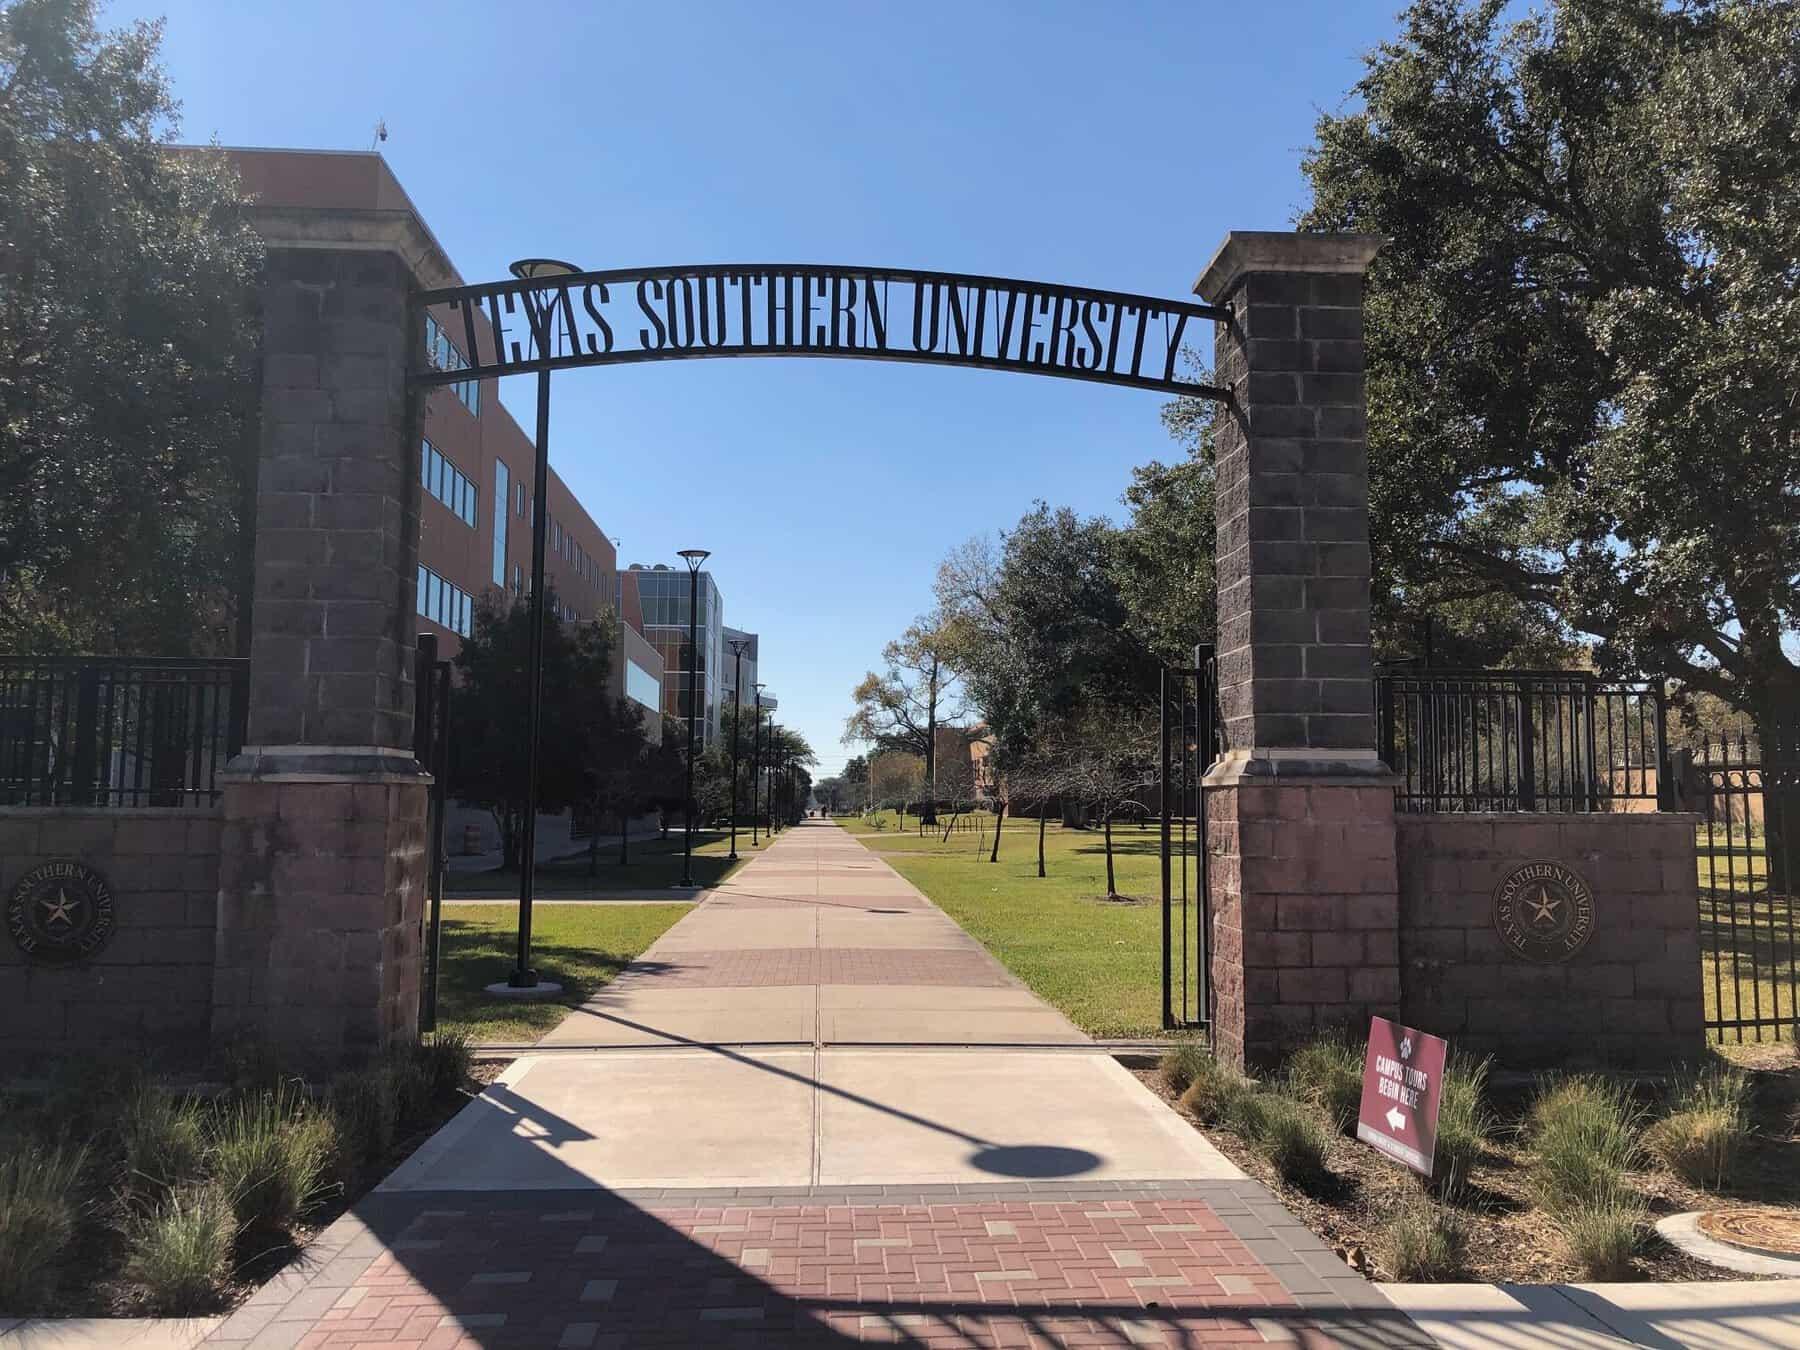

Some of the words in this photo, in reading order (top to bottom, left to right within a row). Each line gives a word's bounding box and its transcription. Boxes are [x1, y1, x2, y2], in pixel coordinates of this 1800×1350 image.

[449, 280, 614, 369] TEXAS
[637, 273, 888, 352] SOUTHERN
[912, 277, 1189, 384] UNIVERSITY
[1502, 864, 1564, 903] SOUTHERN
[1499, 905, 1527, 951] TEXAS
[1564, 875, 1591, 951] UNIVERSITY
[1375, 1055, 1404, 1081] CAMPUS
[1405, 1066, 1428, 1091] TOURS
[1379, 1076, 1400, 1101] BEGIN
[1400, 1085, 1418, 1110] HERE
